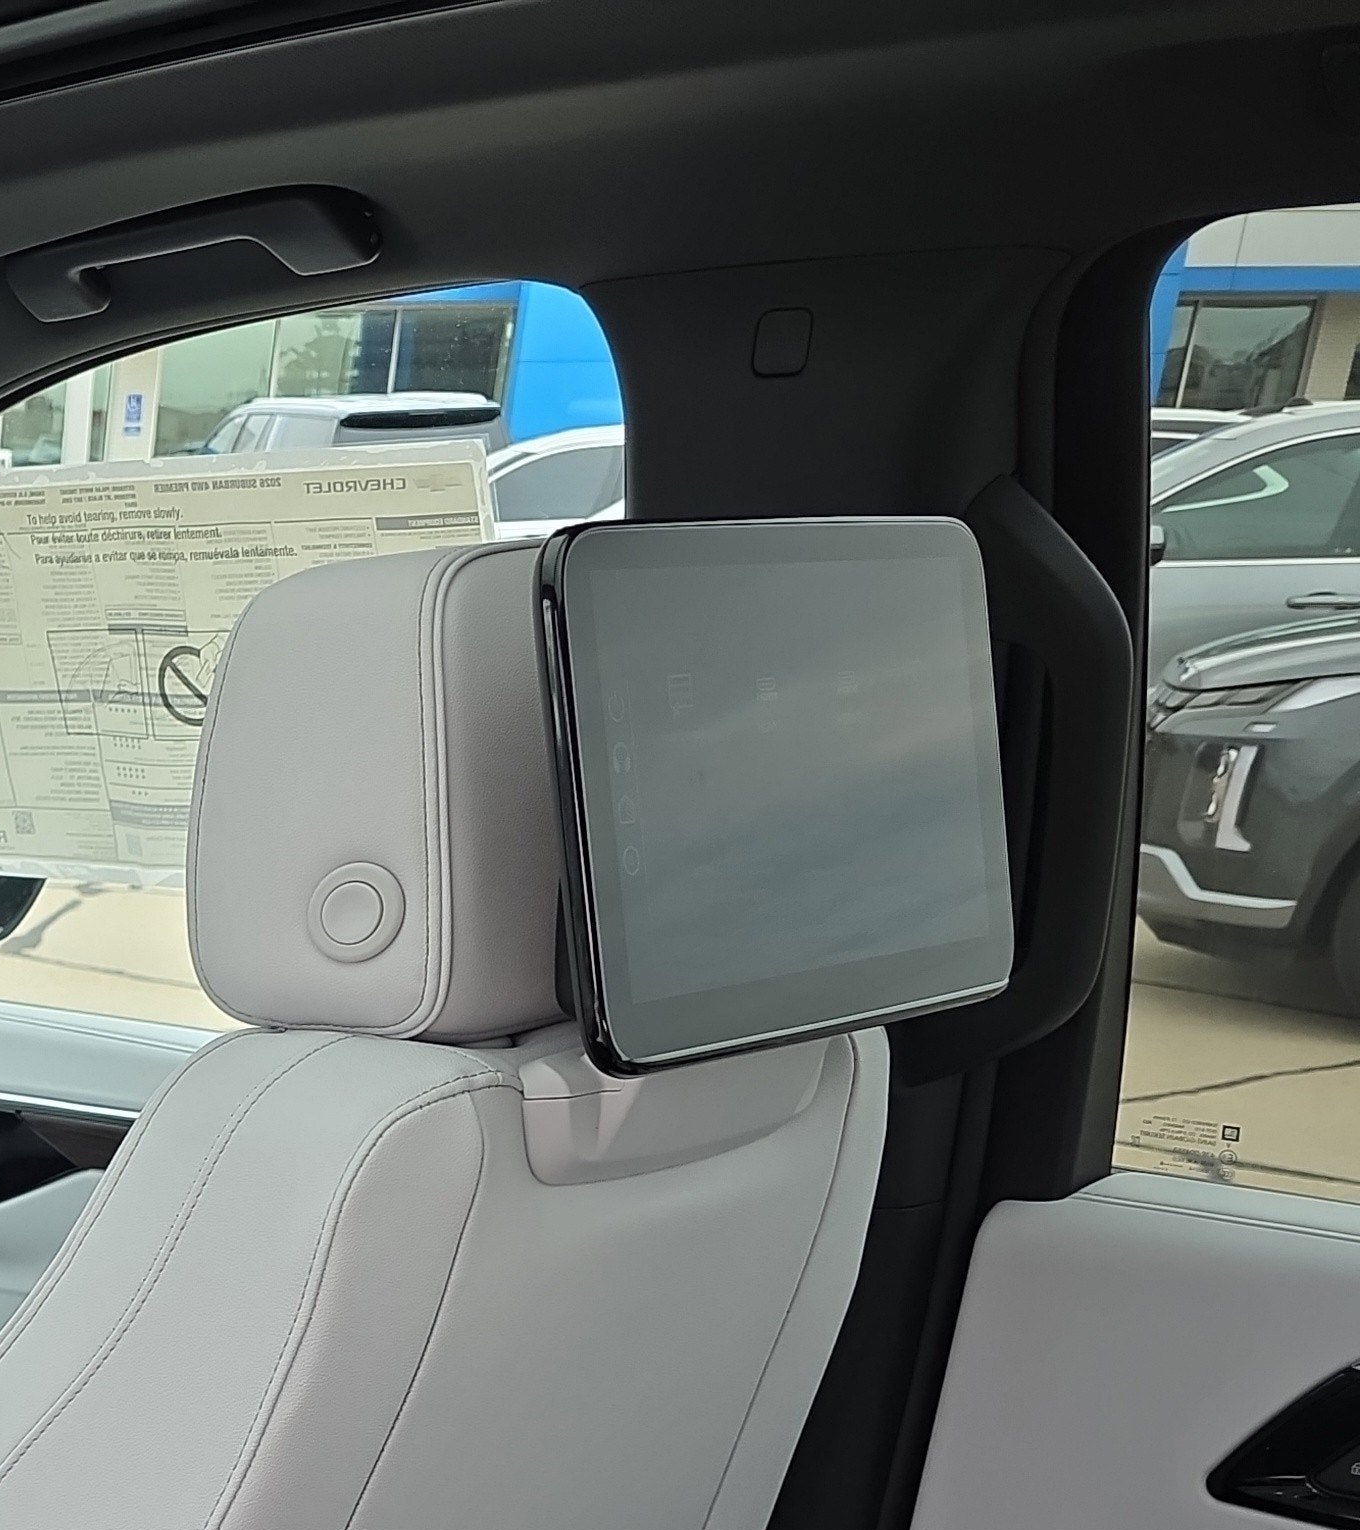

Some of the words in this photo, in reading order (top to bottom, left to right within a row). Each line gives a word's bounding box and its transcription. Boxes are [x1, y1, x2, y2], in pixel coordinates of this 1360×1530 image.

[27, 514, 37, 525] To
[38, 513, 57, 527] help
[59, 511, 81, 523] avoid
[84, 509, 118, 523] tearing,
[119, 509, 151, 520] remove
[153, 506, 183, 521] slowly.
[173, 527, 222, 540] lentement.
[35, 553, 54, 564] Para
[242, 544, 298, 558] lentamente.
